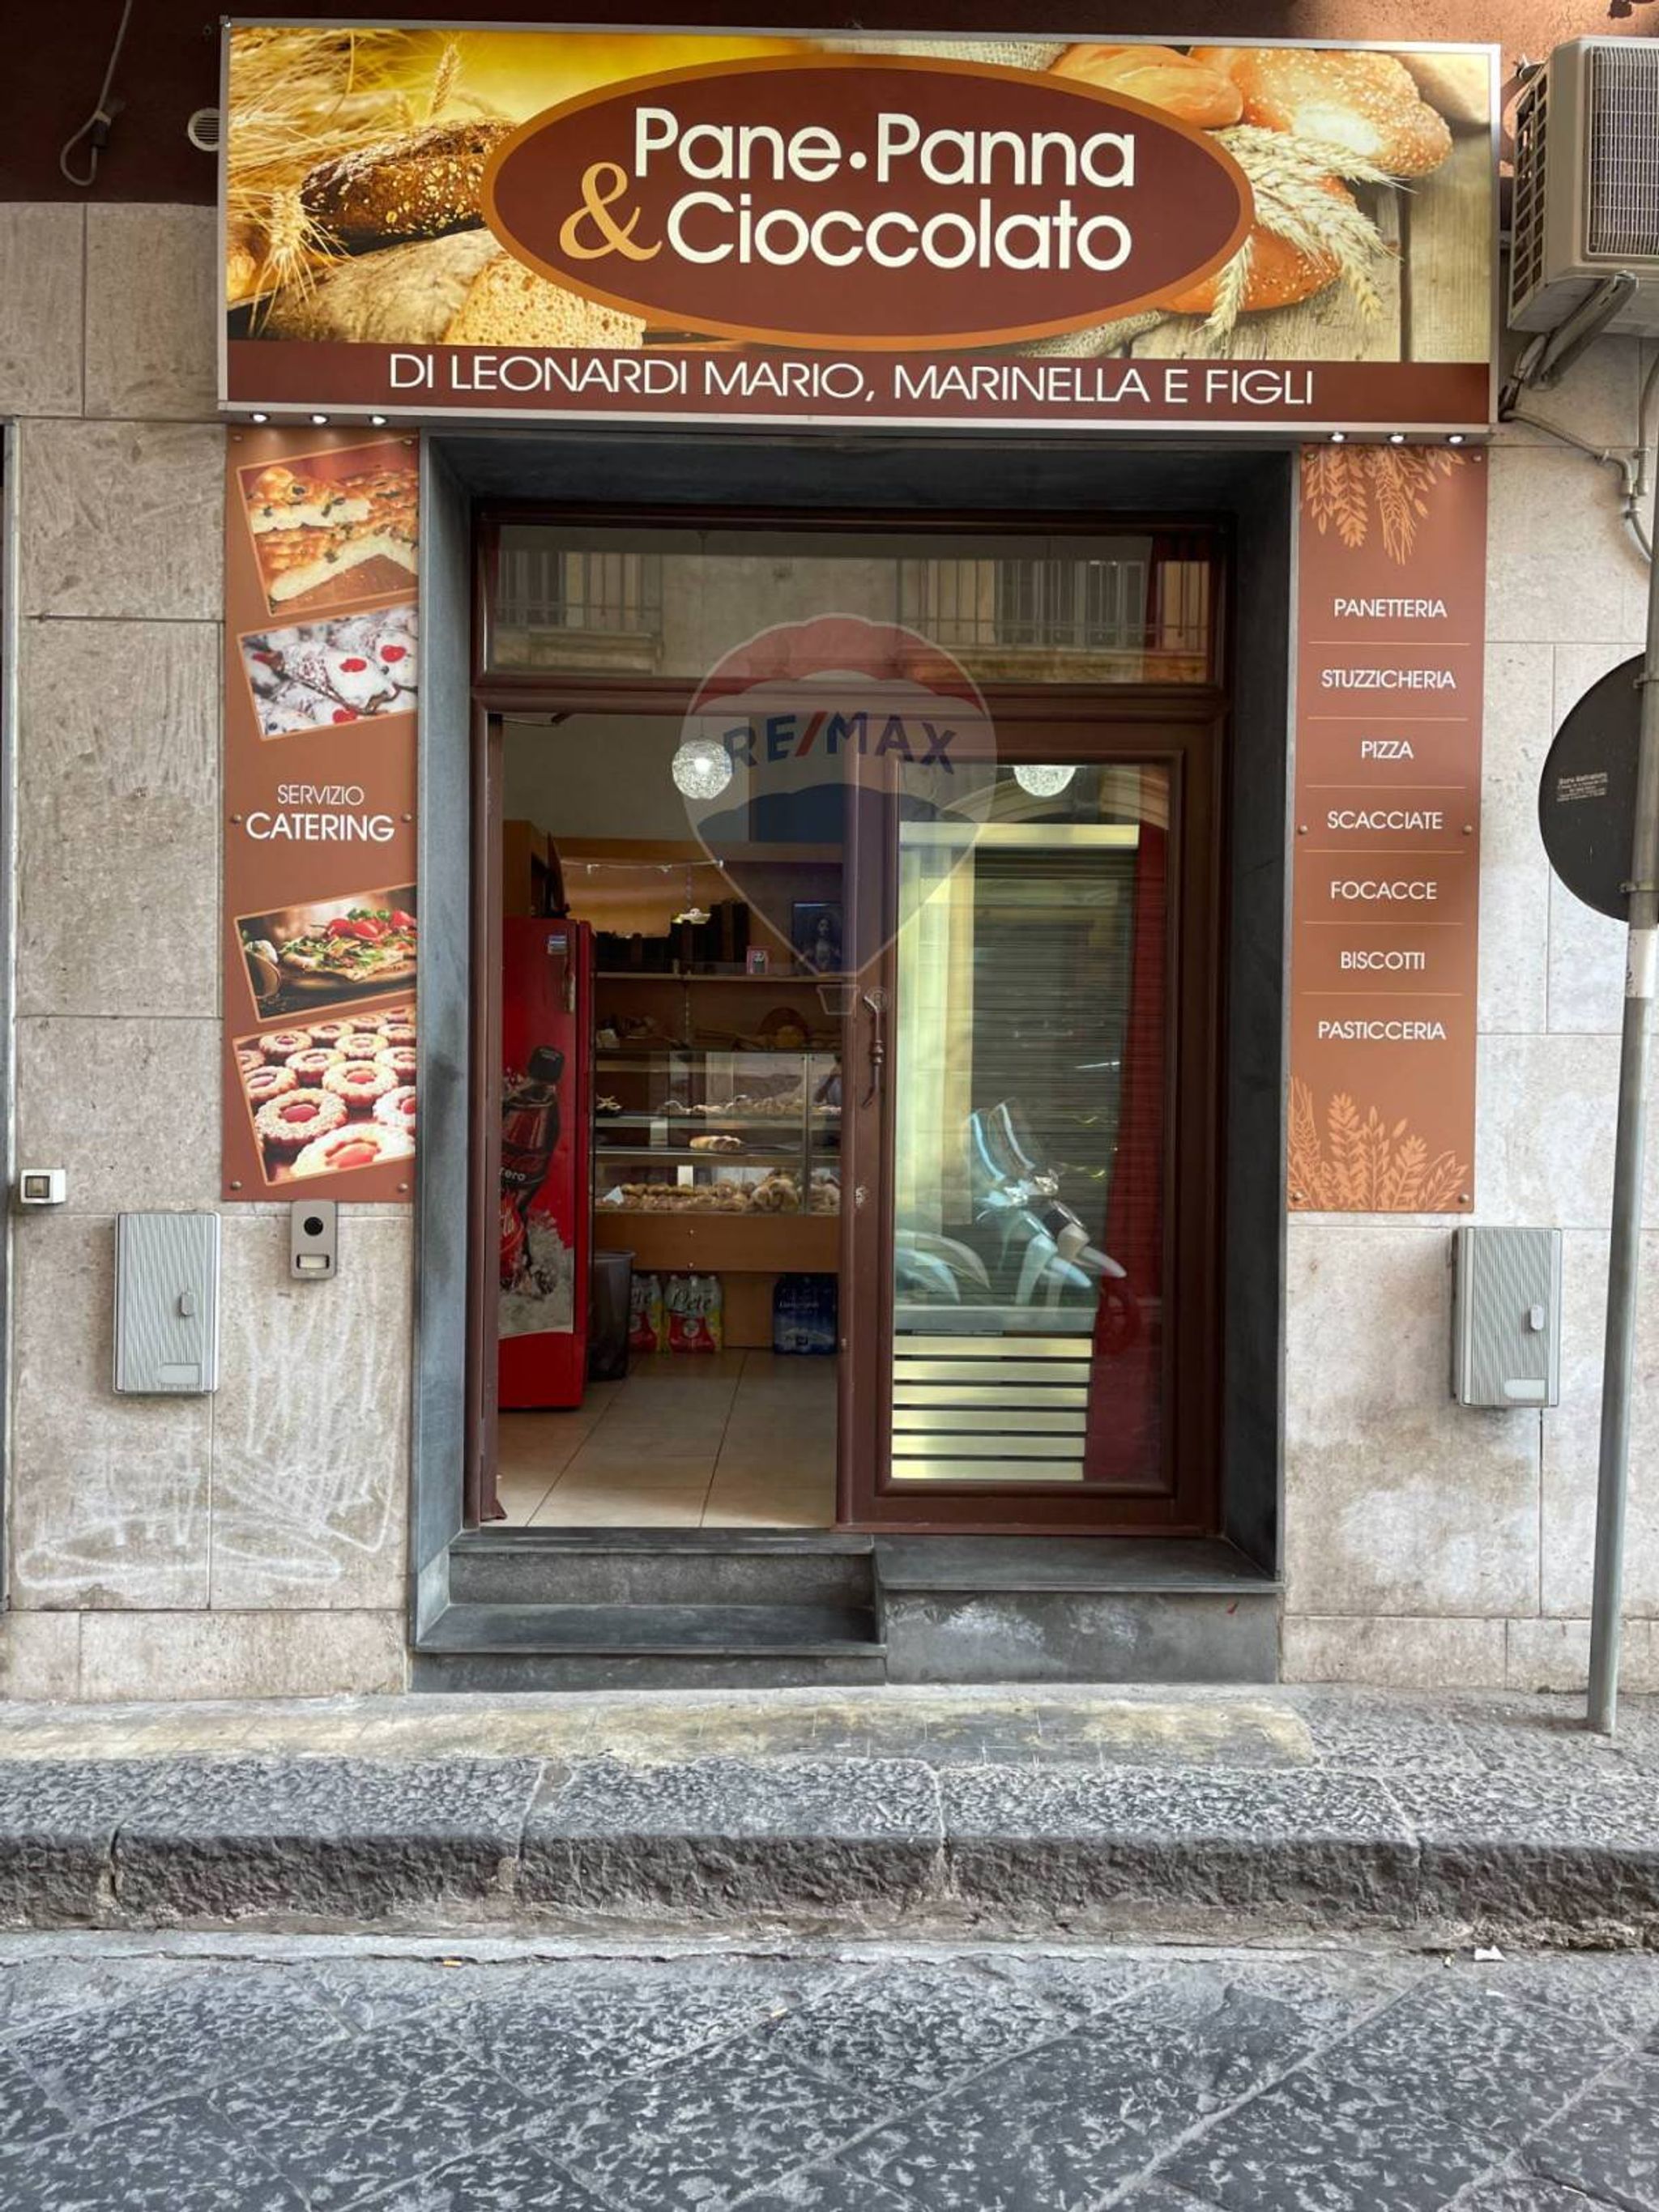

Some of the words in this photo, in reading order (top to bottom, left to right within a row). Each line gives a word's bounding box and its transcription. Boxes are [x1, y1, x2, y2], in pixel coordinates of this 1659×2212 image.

[876, 113, 1135, 188] Panna
[560, 162, 663, 261] &
[667, 191, 1132, 271] Cioccolato
[390, 353, 433, 389] DI
[451, 355, 687, 394] LEONARDI
[705, 360, 875, 403] MARIO,
[894, 363, 1152, 403] MARINELLA
[1164, 369, 1188, 403] E
[1205, 369, 1313, 405] FIGLI
[1333, 598, 1448, 618] PANETTERIA
[1321, 668, 1456, 689] STUZZICHERIA
[1361, 740, 1414, 759] PIZZA
[277, 783, 365, 806] SERVIZIO
[245, 812, 395, 842] CATERING
[1327, 811, 1443, 830] SCACCIATE
[1330, 880, 1437, 901] FOCACCE
[1340, 951, 1425, 970] BISCOTTI
[1318, 1021, 1447, 1040] PASTICCERIA
